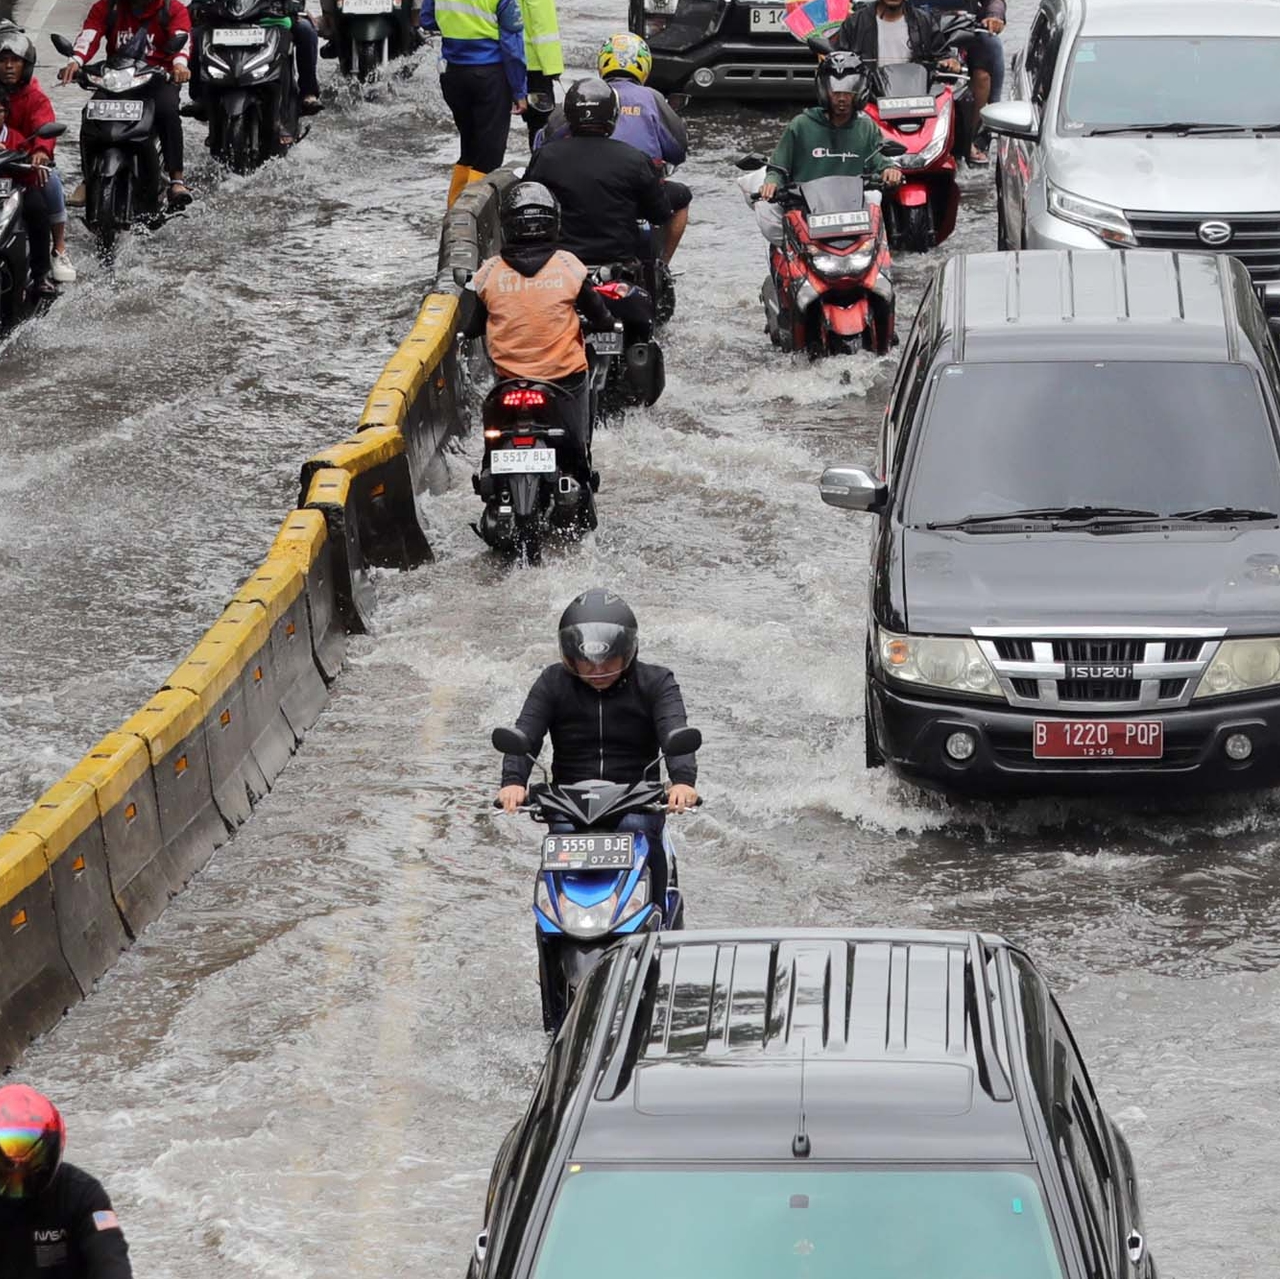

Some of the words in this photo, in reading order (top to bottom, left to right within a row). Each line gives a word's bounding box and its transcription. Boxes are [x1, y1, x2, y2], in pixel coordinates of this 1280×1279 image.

[752, 10, 761, 24] B
[524, 276, 564, 289] Food
[493, 452, 500, 463] B
[503, 451, 528, 463] 5517
[533, 450, 554, 461] BLX
[1071, 667, 1128, 678] ISUZU
[1036, 723, 1047, 745] B
[1063, 723, 1108, 746] 1220
[1125, 723, 1160, 746] PQP
[548, 840, 556, 852] B
[604, 838, 629, 851] BJE
[34, 1229, 67, 1241] NASA
